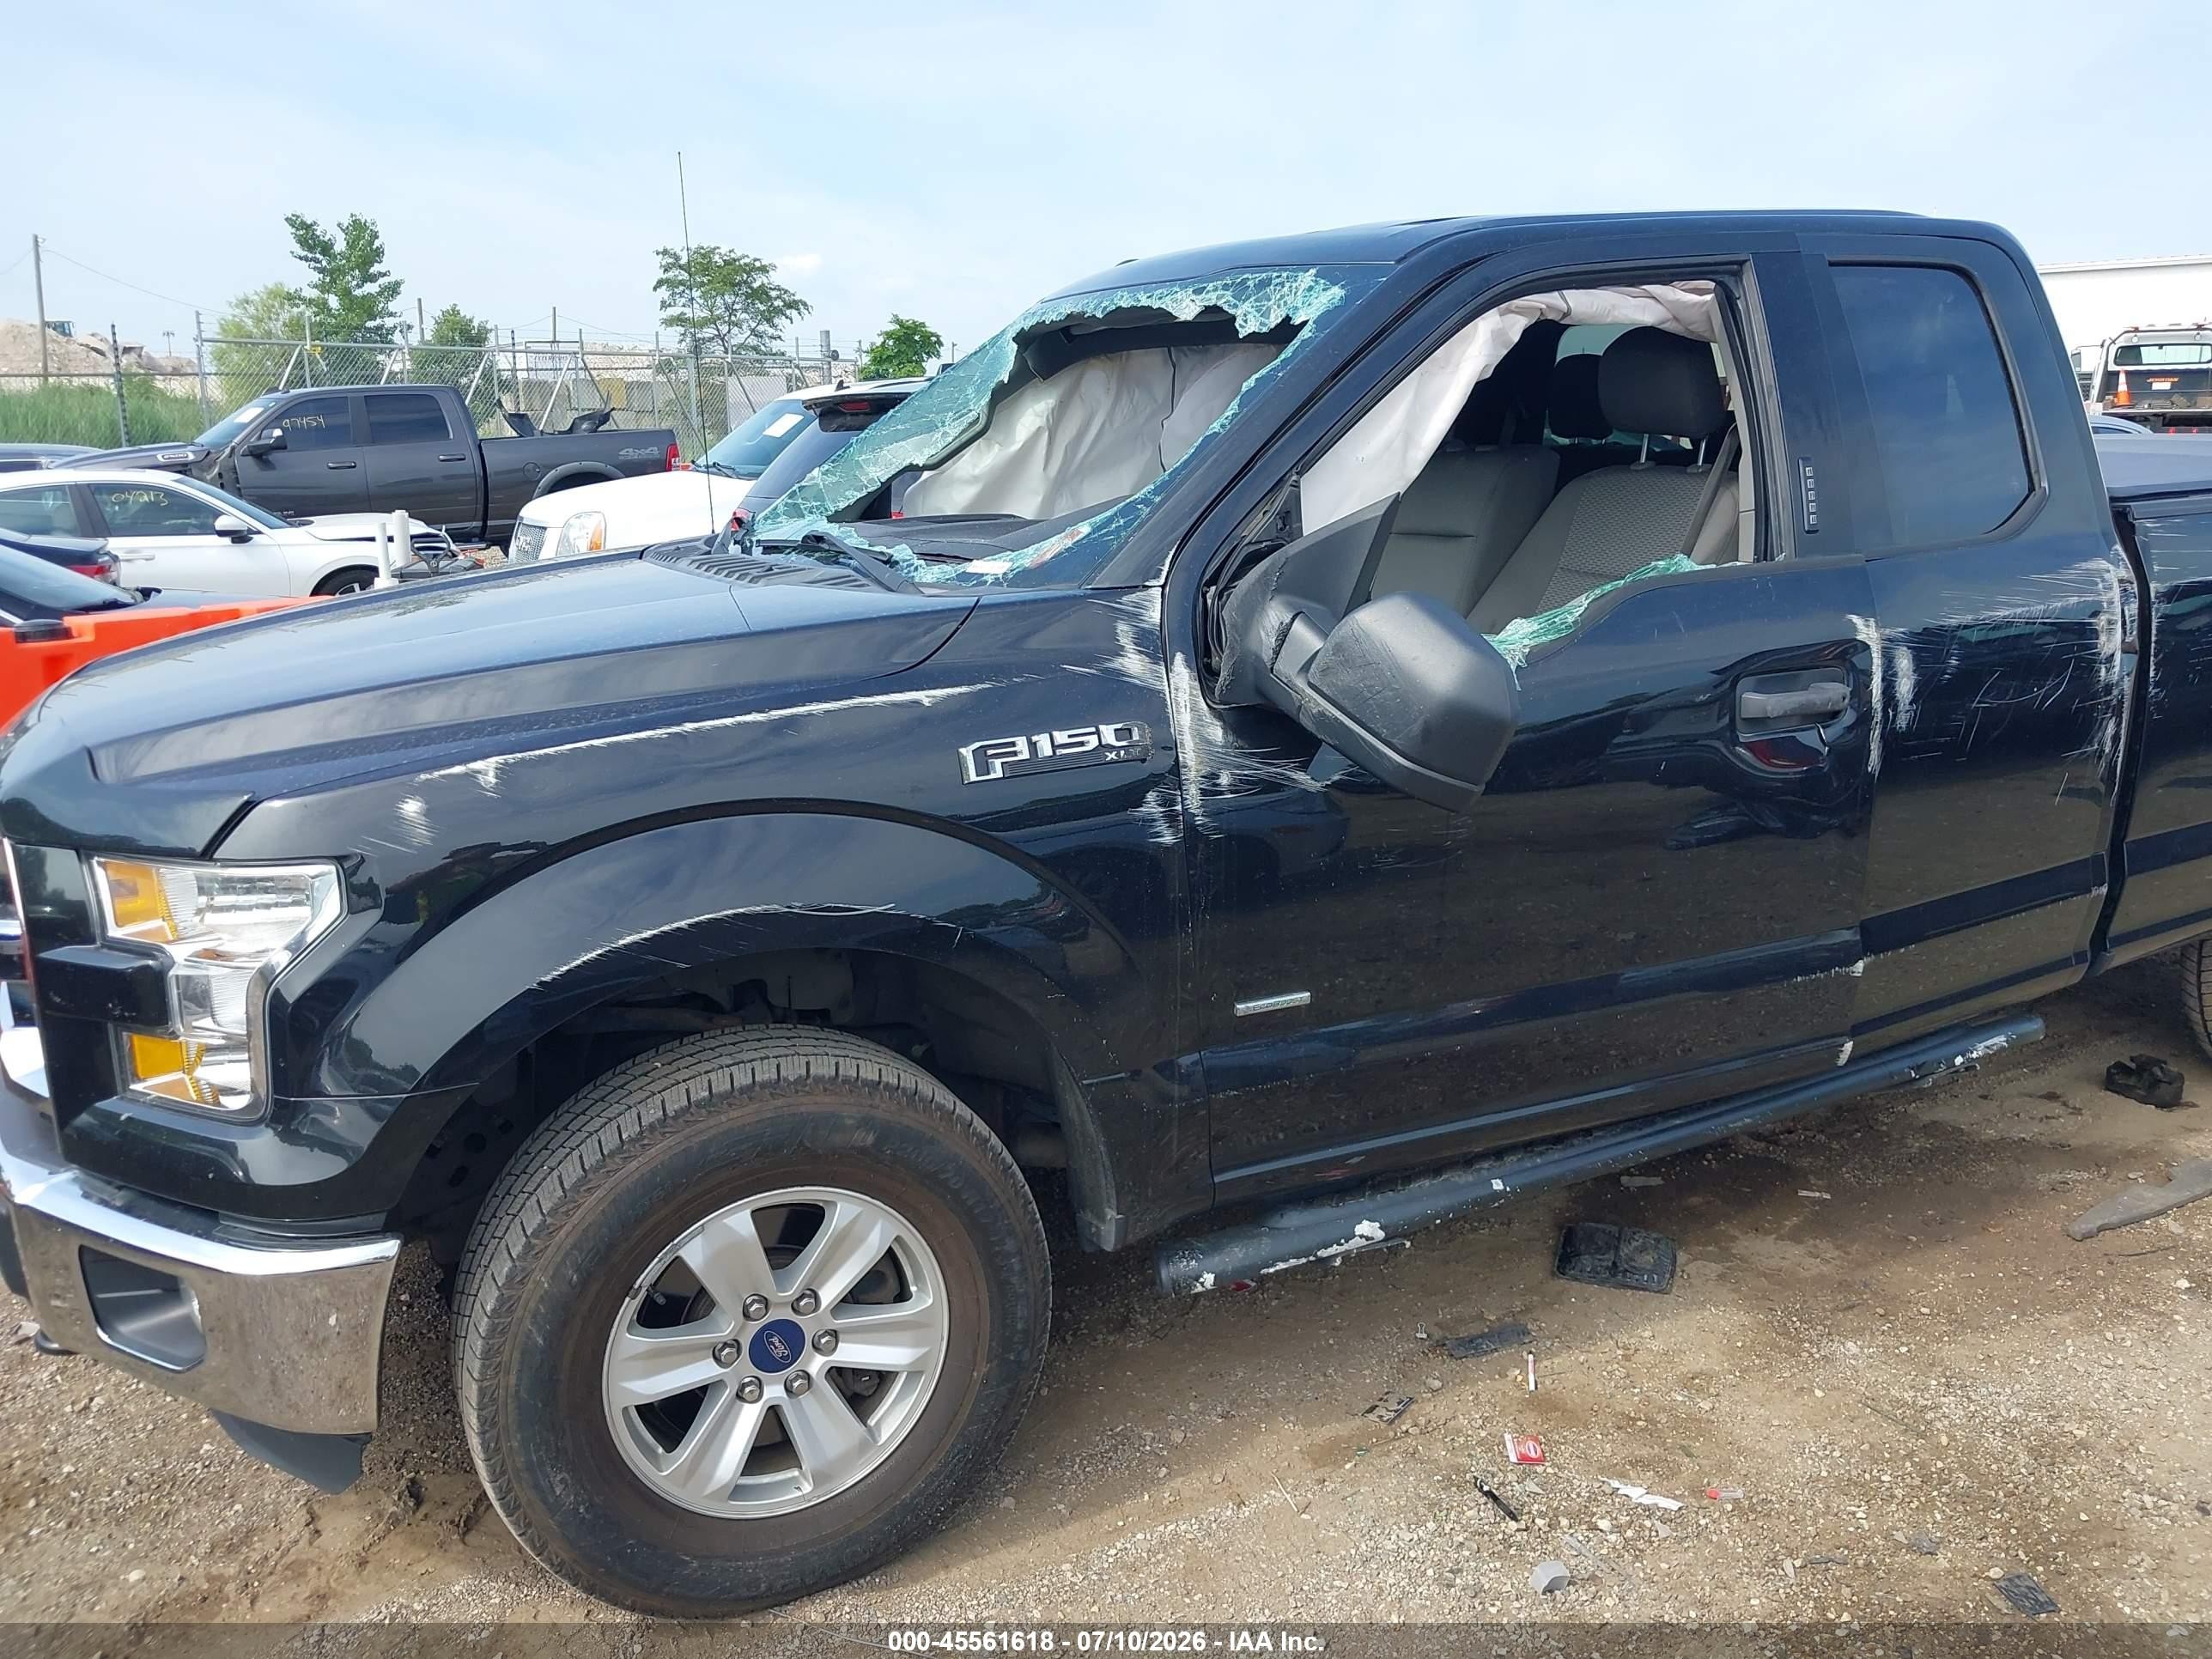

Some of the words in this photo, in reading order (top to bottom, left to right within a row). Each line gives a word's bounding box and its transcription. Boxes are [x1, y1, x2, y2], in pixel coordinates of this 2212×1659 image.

[283, 415, 325, 432] 97454
[112, 490, 168, 507] 04213
[768, 1336, 788, 1358] Ford
